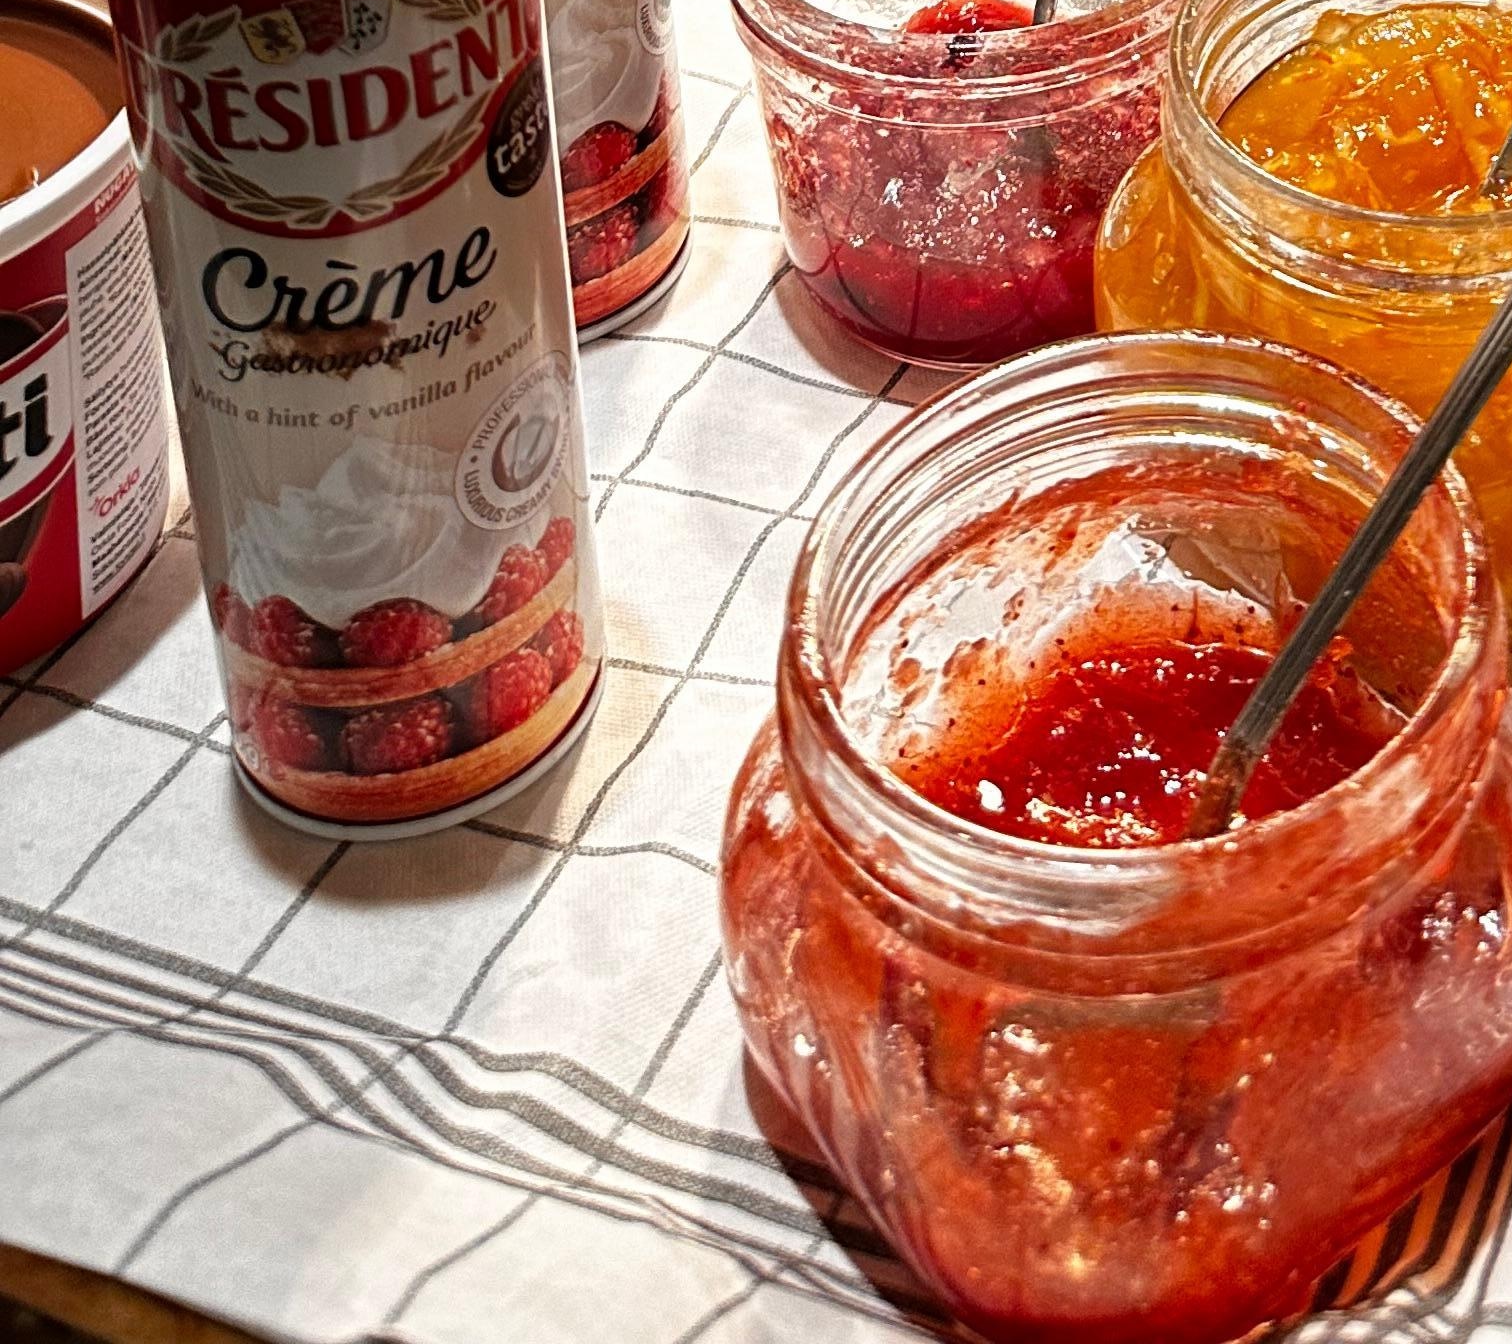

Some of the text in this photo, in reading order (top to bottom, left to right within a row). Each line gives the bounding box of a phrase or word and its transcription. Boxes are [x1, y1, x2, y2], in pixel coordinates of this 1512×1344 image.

[202, 226, 497, 334] Crème
[191, 323, 536, 430] With a hint of vanilla flavour
[212, 299, 497, 382] Gastronomique
